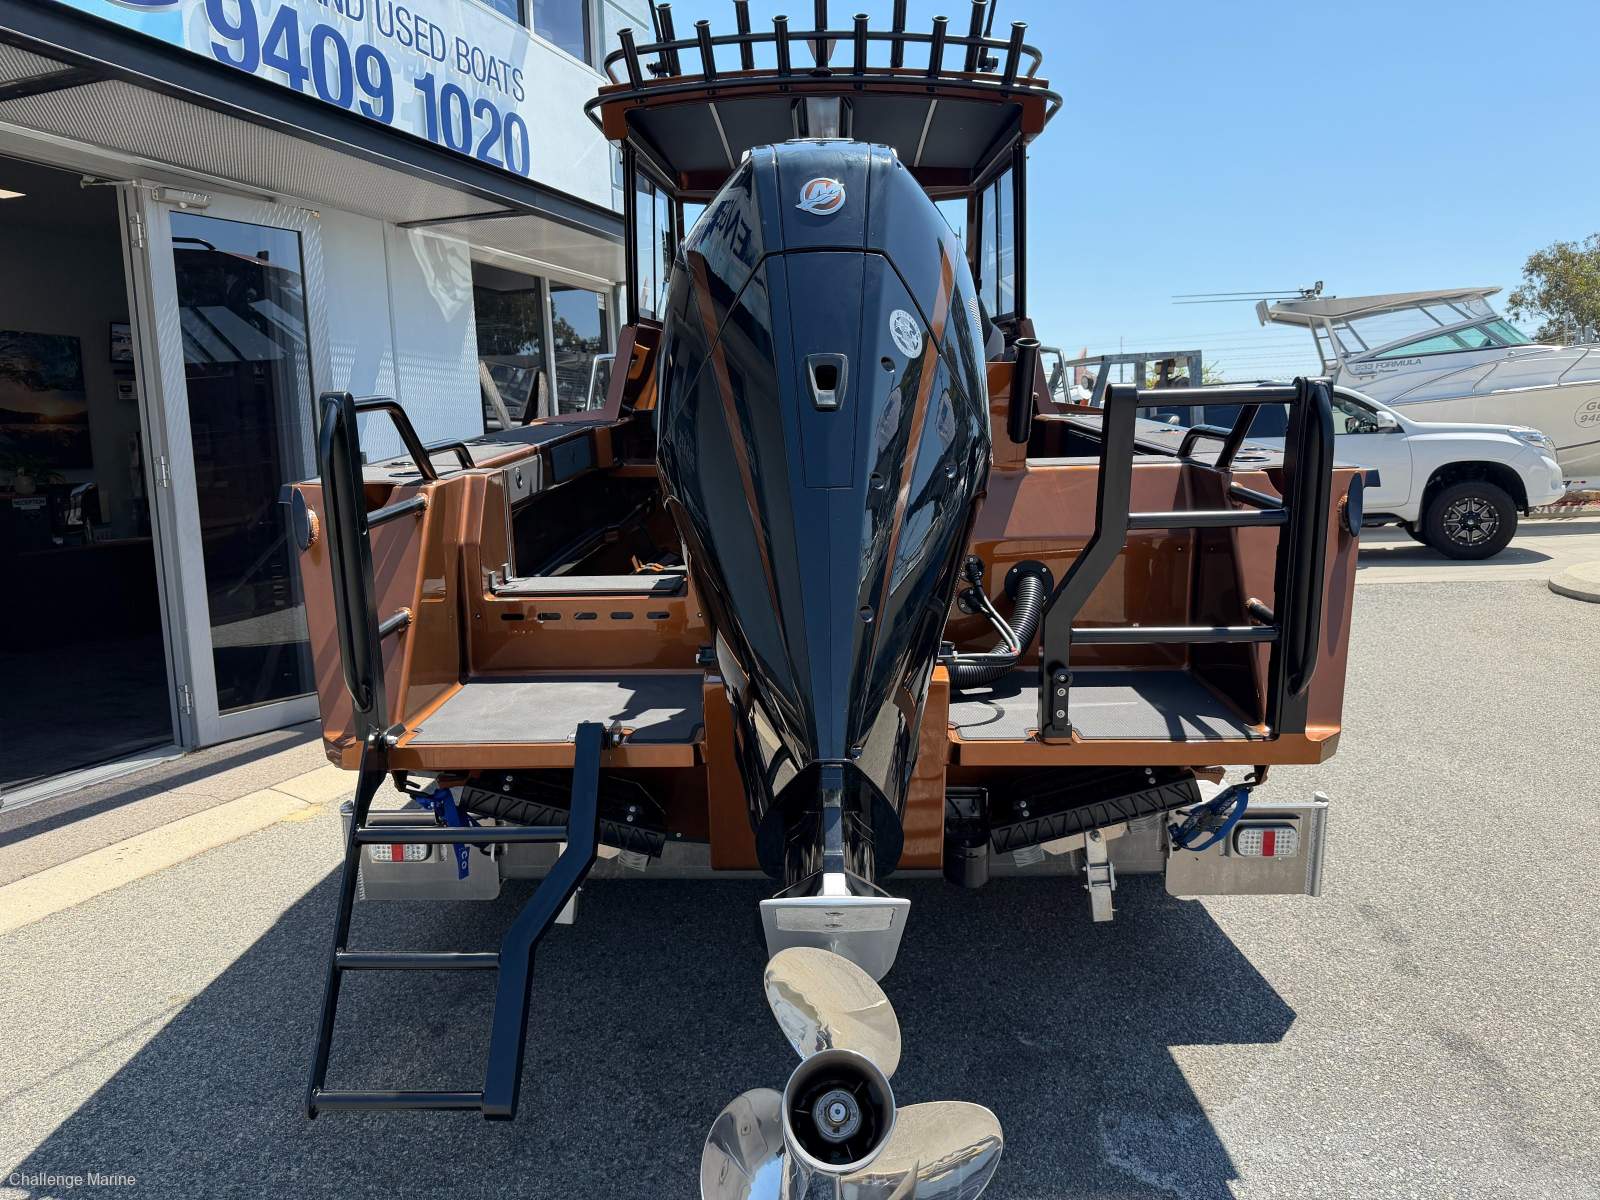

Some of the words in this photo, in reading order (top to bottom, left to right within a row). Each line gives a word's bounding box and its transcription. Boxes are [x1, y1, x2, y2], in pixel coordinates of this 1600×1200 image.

[205, 0, 394, 125] 9409
[414, 72, 530, 177] 1020
[376, 0, 446, 63] USED
[455, 37, 525, 102] BOATS
[1376, 359, 1422, 369] FORMULA
